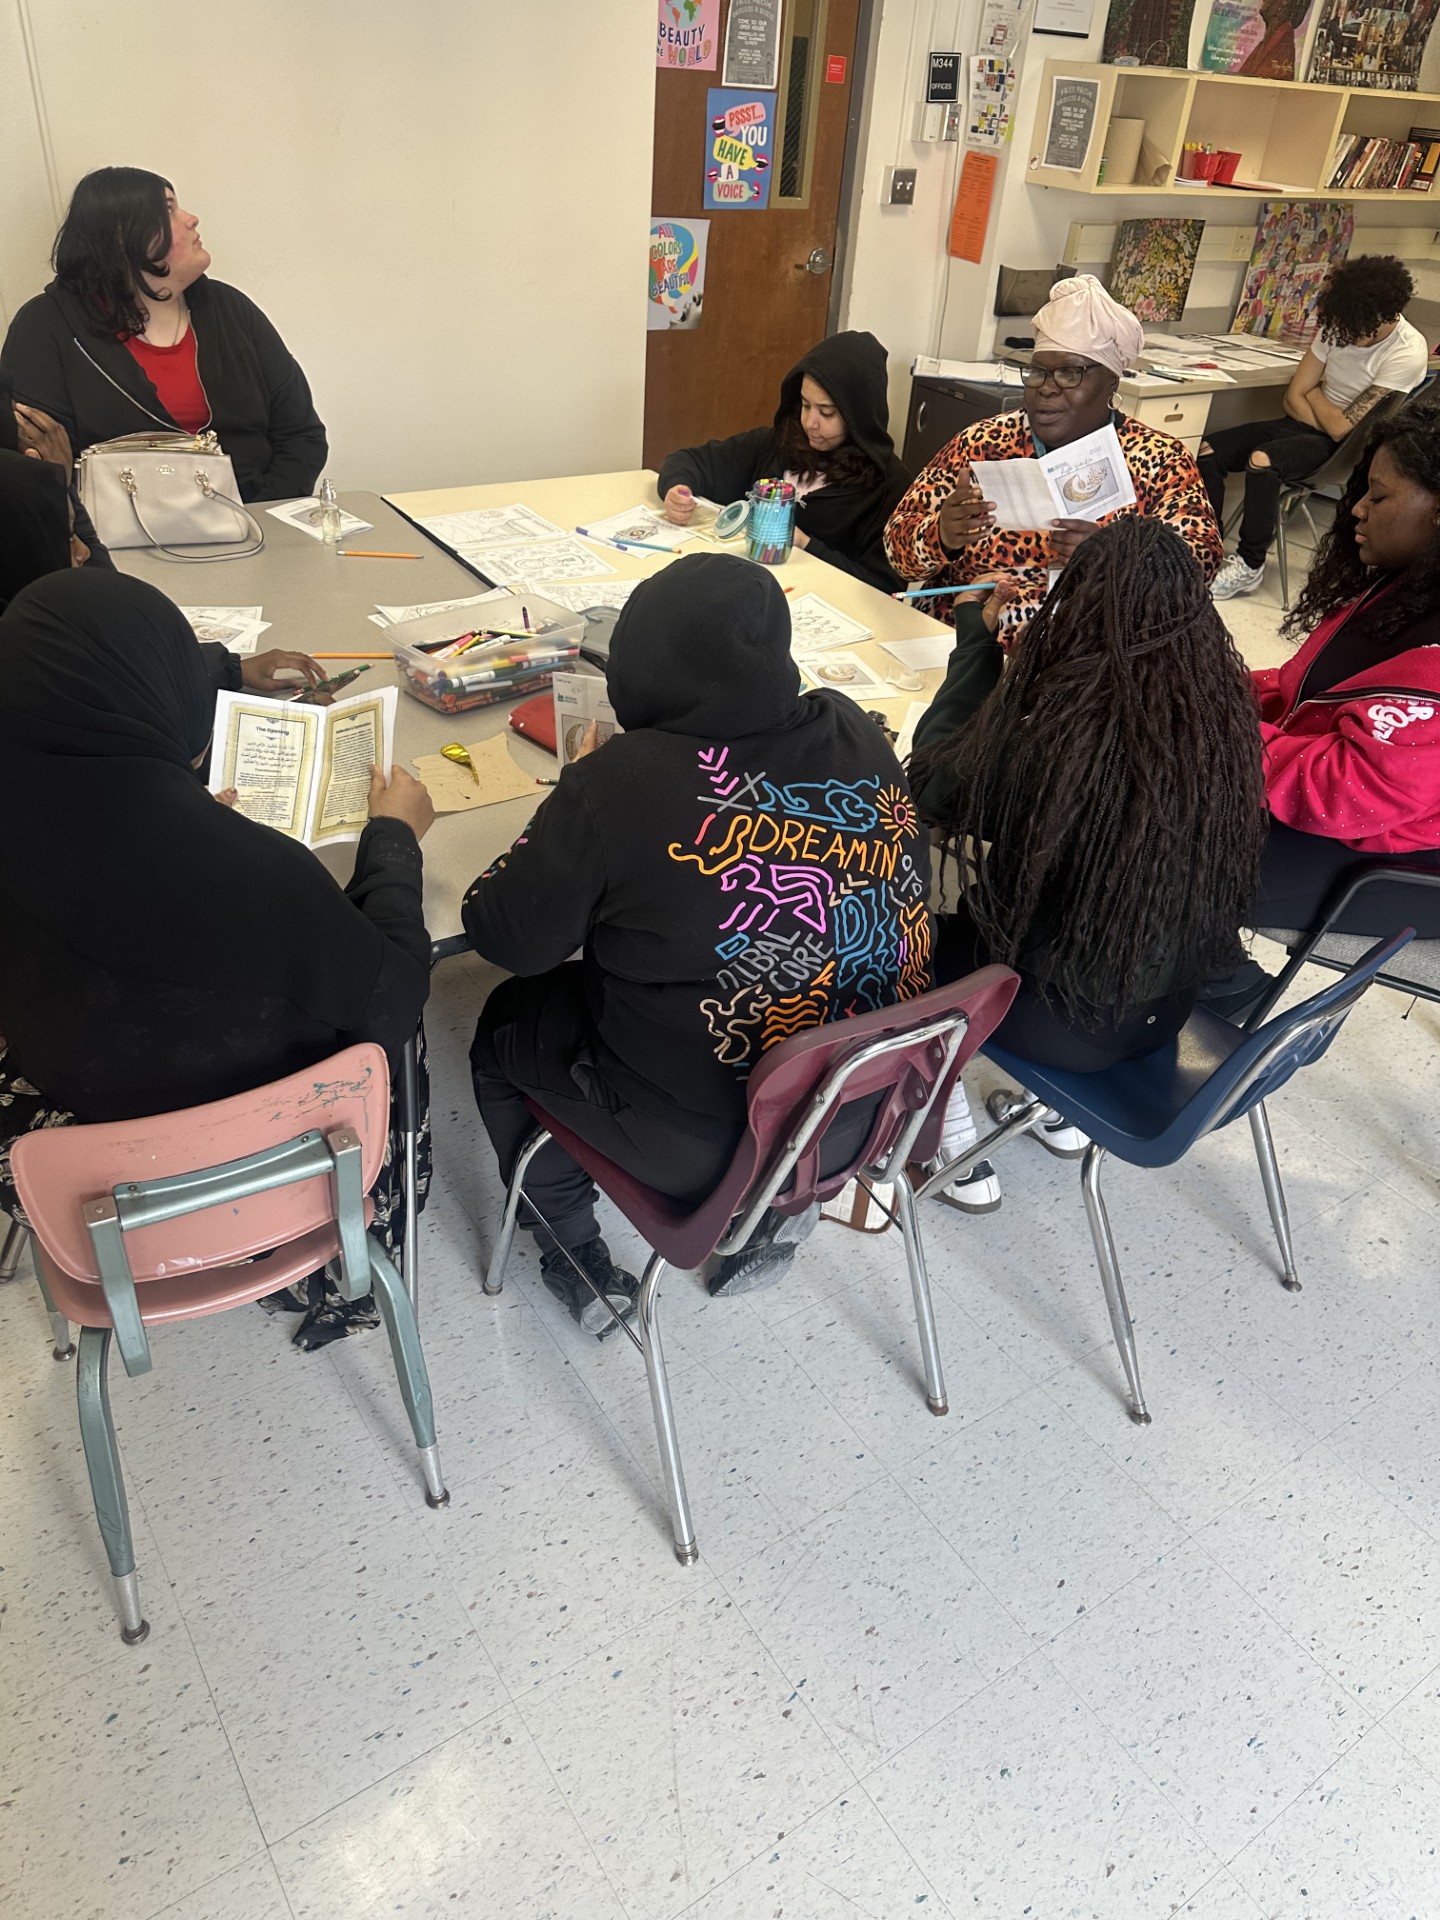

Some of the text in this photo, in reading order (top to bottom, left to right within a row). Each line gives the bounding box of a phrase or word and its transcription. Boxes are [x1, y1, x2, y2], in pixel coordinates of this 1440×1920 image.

[660, 21, 706, 46] BEAUTY
[668, 39, 712, 66] WORLD
[932, 58, 953, 68] M344
[931, 82, 952, 90] OFFICES
[728, 105, 764, 127] PSSST...
[741, 125, 768, 146] YOU
[717, 139, 747, 166] HAVE
[726, 164, 734, 179] A
[717, 184, 744, 198] VOICE
[658, 225, 674, 240] ALL
[651, 242, 682, 260] COLORS
[661, 259, 677, 274] ARE
[267, 728, 289, 736] Opening
[770, 933, 834, 992] CORE
